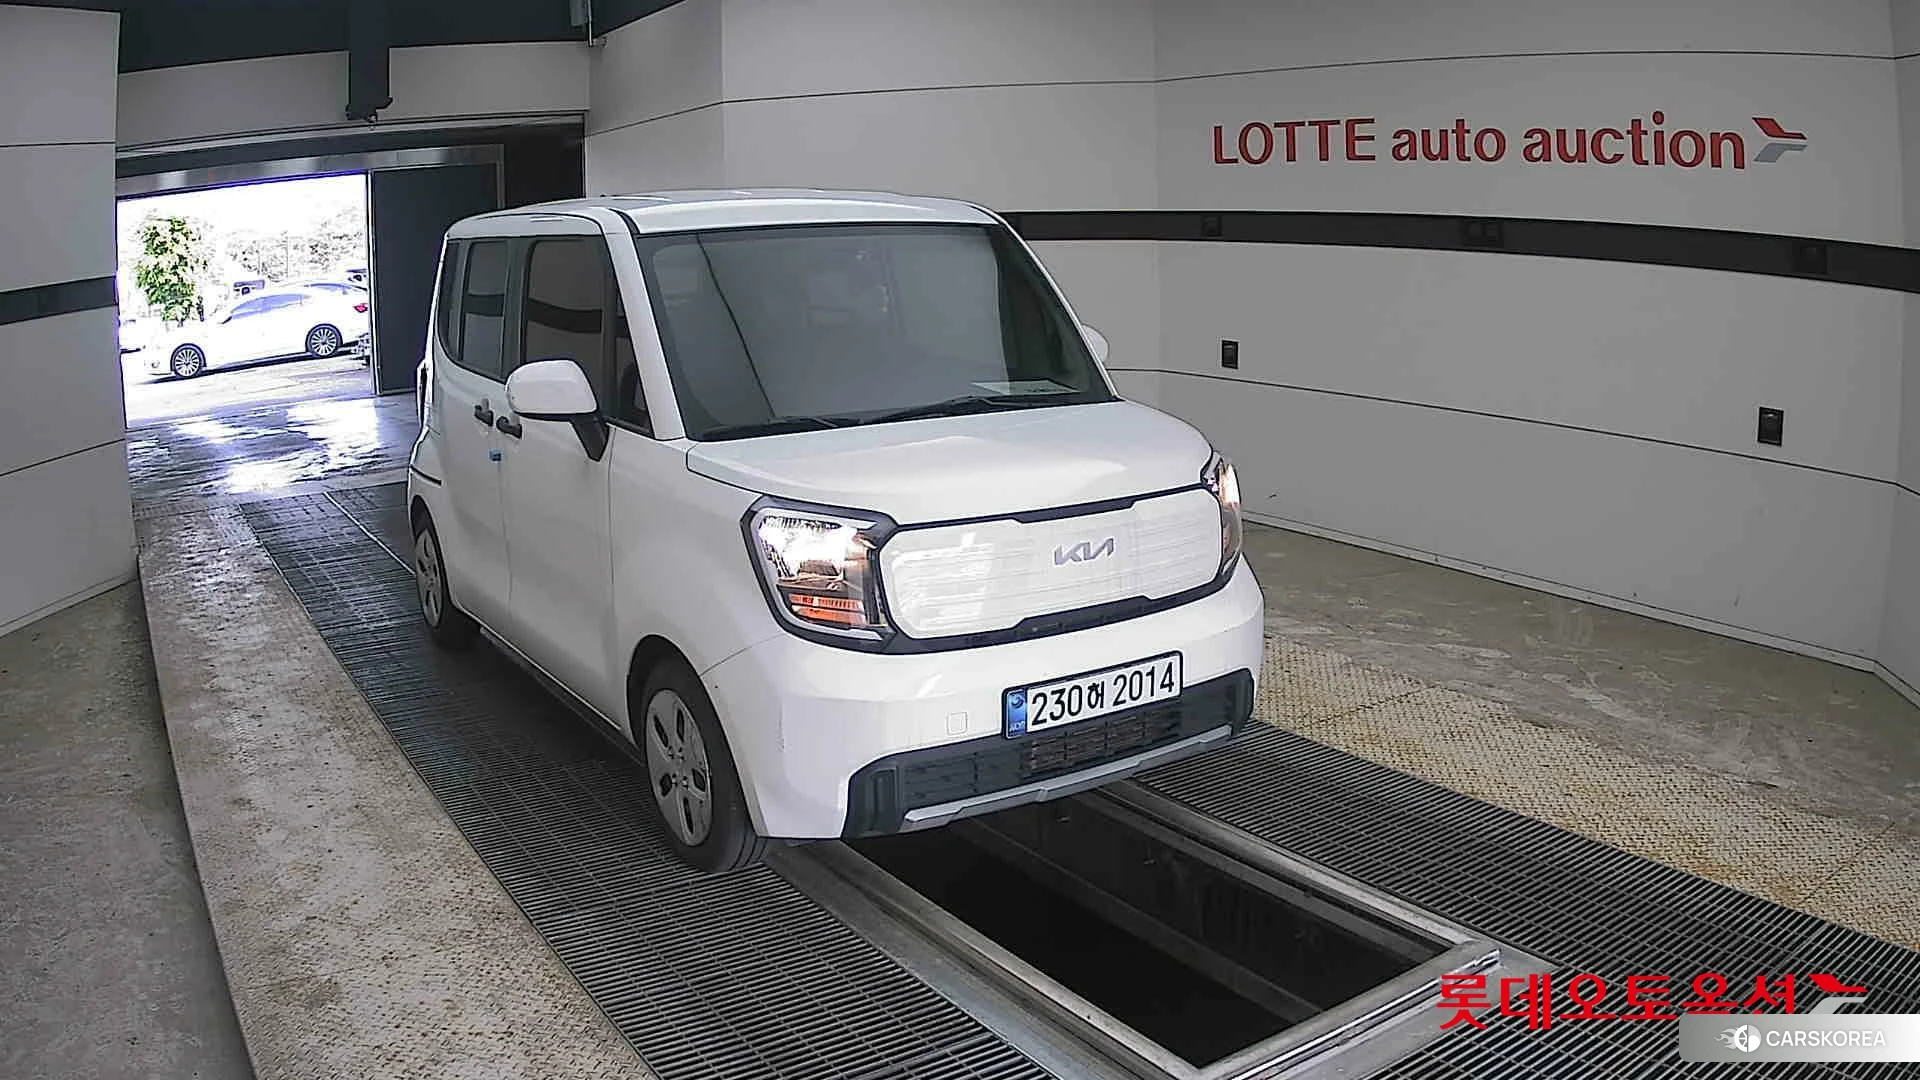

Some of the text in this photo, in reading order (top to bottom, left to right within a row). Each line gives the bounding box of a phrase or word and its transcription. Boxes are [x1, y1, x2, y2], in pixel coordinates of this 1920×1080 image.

[1212, 111, 1746, 170] LOTTE auto auction
[1054, 537, 1114, 566] KIA
[1112, 661, 1175, 707] 2014
